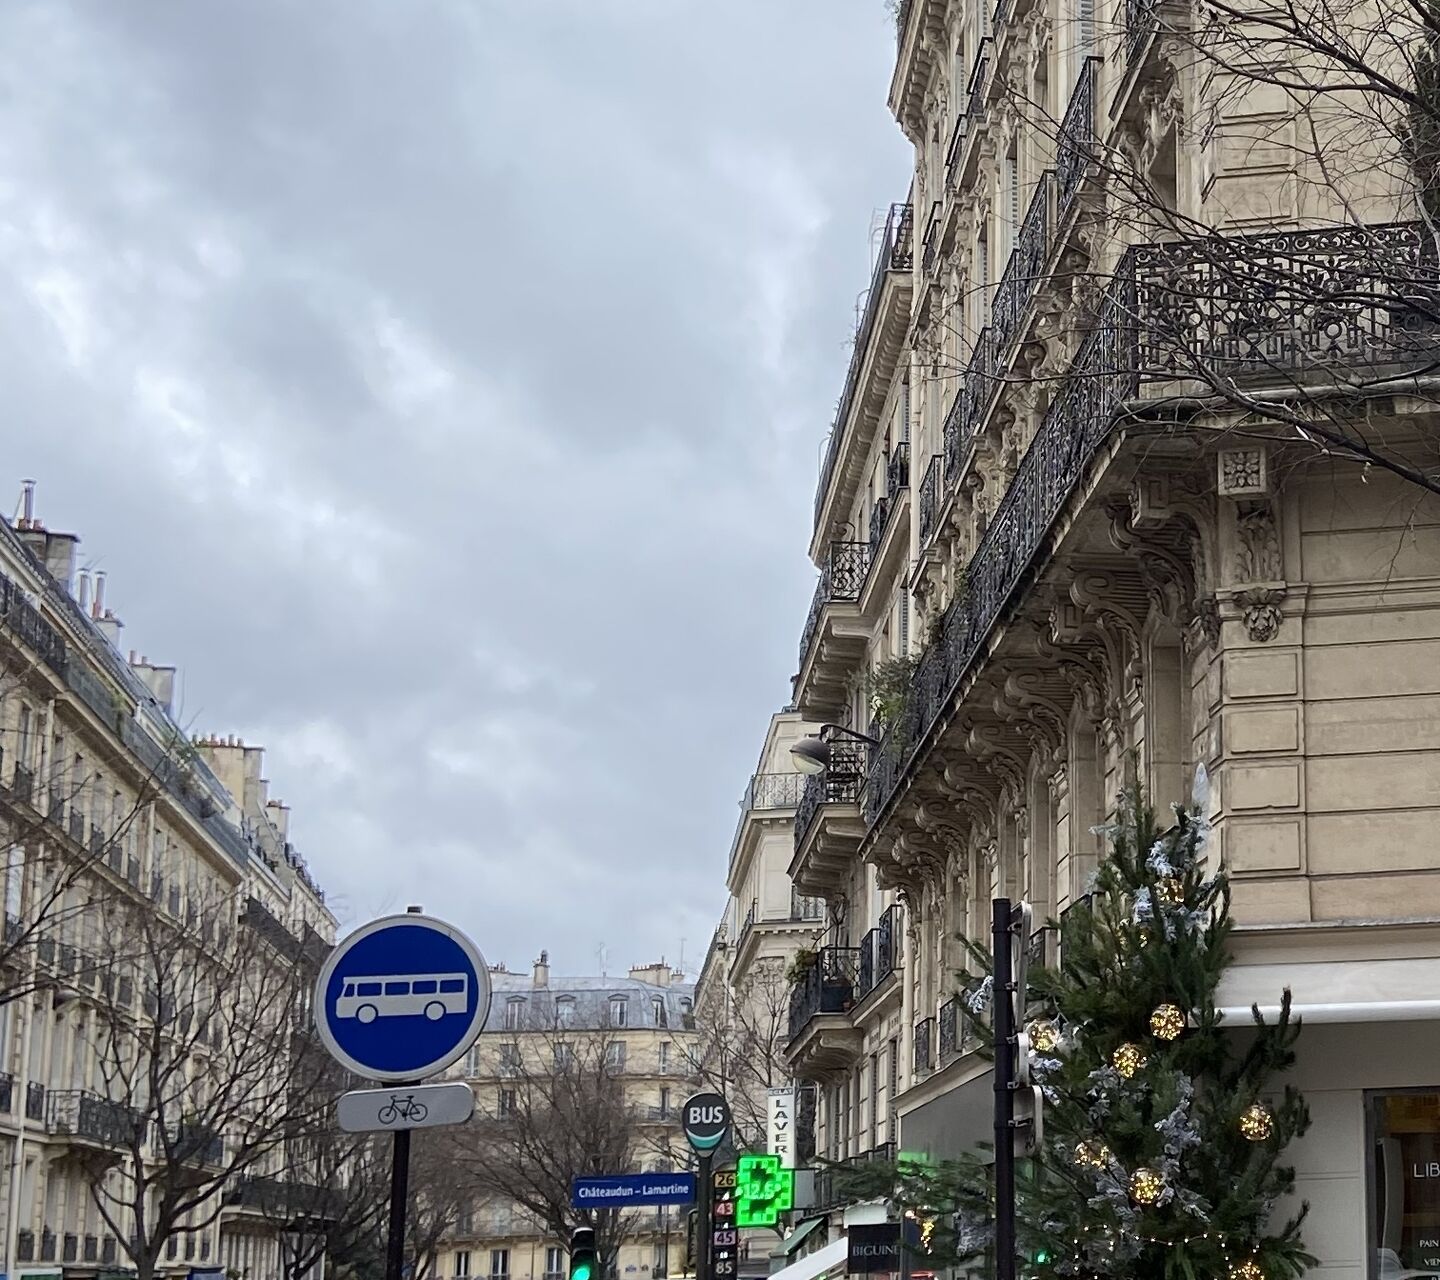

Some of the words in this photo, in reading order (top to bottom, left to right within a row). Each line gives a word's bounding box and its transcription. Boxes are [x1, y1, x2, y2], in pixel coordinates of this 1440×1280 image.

[689, 1106, 724, 1124] BUS
[717, 1173, 735, 1186] 26
[578, 1186, 633, 1198] Châteaudun
[642, 1183, 689, 1196] Lamartine
[716, 1202, 733, 1215] 43
[716, 1232, 733, 1244] 45
[1419, 1239, 1440, 1248] PAIN
[715, 1260, 733, 1274] 85
